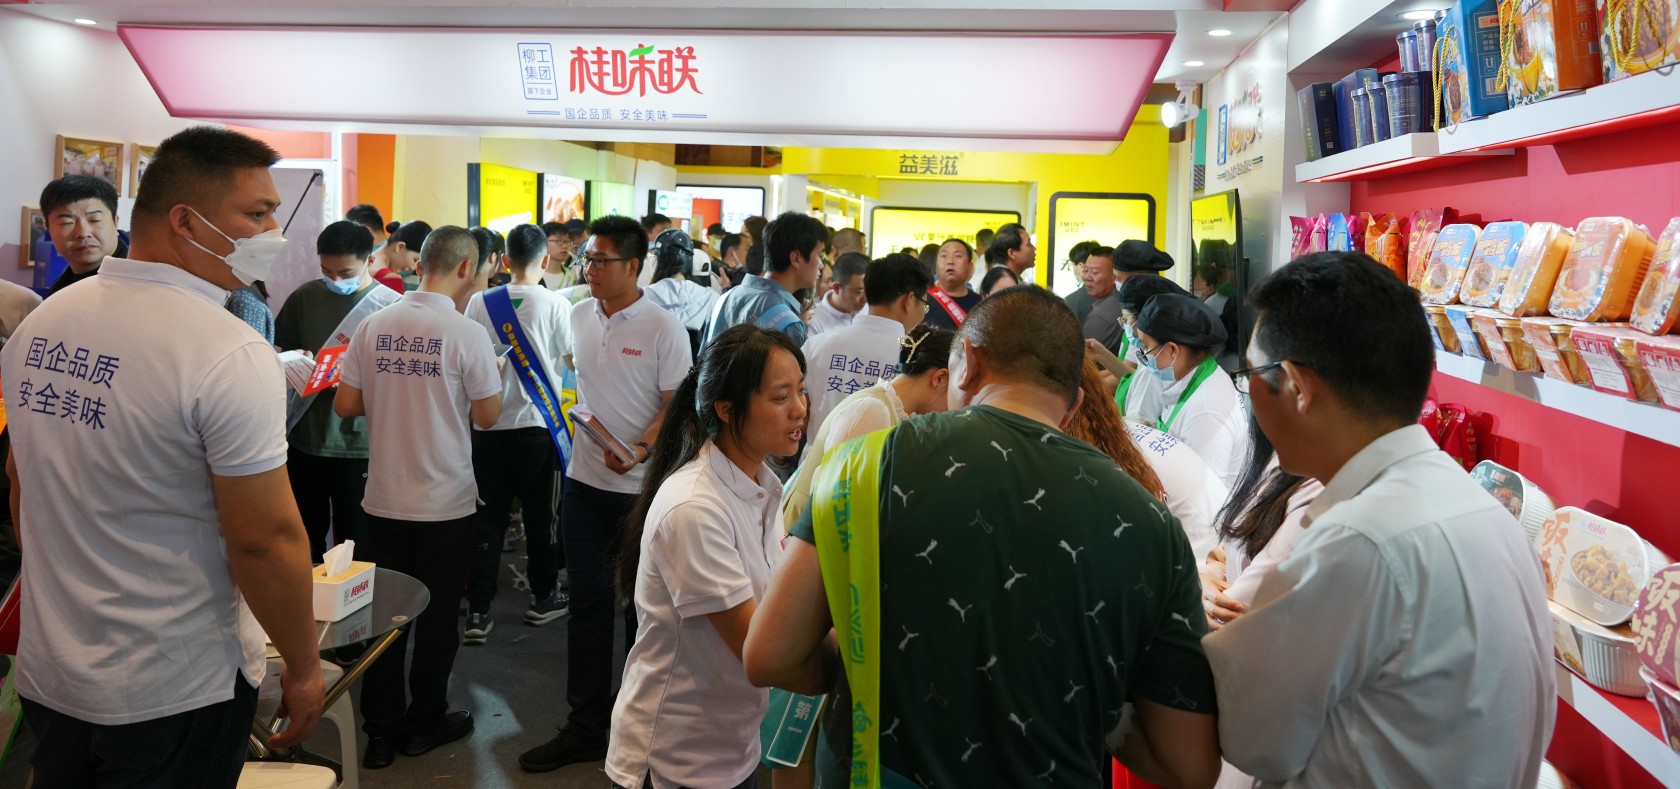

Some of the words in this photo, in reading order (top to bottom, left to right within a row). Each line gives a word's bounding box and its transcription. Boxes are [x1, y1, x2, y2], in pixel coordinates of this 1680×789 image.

[522, 48, 550, 63] 柳工
[524, 65, 551, 81] 集团
[569, 43, 704, 97] 桂味联
[564, 107, 613, 120] 国企品质
[619, 108, 669, 122] 安全美味
[899, 153, 959, 175] 益美滋
[376, 334, 442, 356] 国企品质
[25, 336, 119, 389] 国企品质
[376, 356, 441, 379] 安全美味
[829, 353, 897, 380] 国企品质
[18, 378, 107, 430] 安全美味
